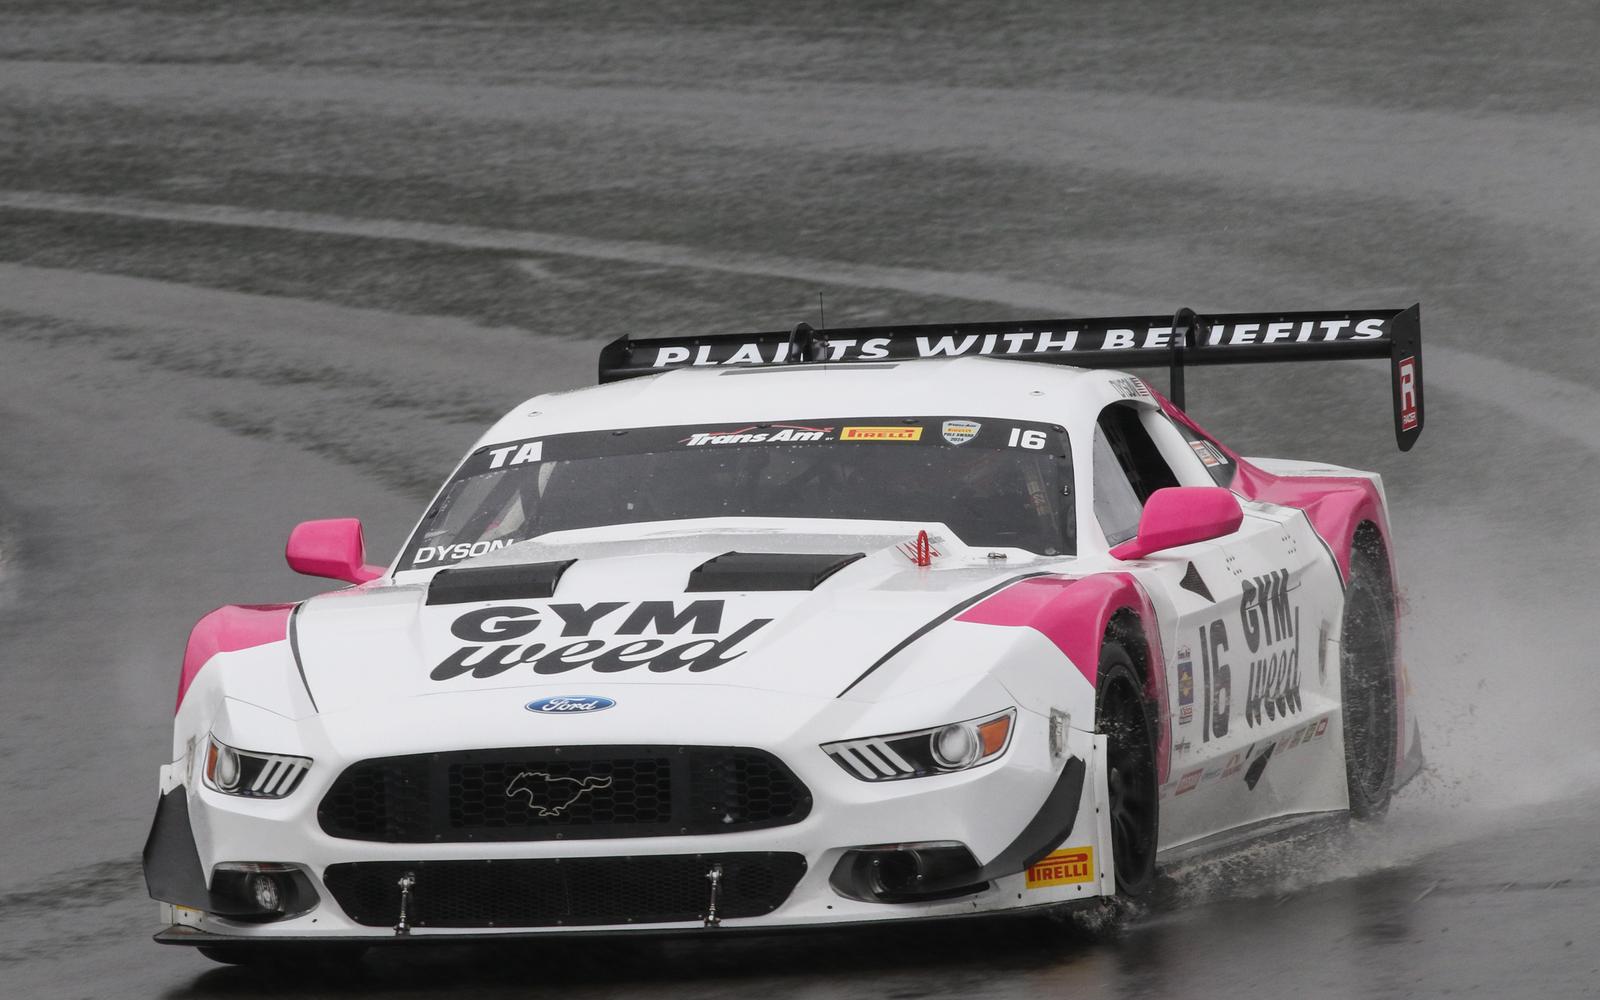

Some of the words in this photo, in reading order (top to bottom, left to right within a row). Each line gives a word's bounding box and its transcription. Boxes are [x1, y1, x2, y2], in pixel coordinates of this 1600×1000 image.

[916, 331, 1079, 357] WITH
[686, 432, 767, 446] Trans
[769, 429, 824, 442] Am
[848, 429, 914, 438] PIRELLI
[1007, 427, 1047, 450] 16
[489, 441, 543, 469] TA
[450, 600, 725, 642] GYM
[1240, 568, 1293, 654] GYM
[429, 618, 775, 681] weed
[1199, 618, 1231, 743] 16
[1245, 606, 1302, 728] weed
[542, 697, 597, 713] Ford
[1028, 853, 1089, 882] PIRELLI
